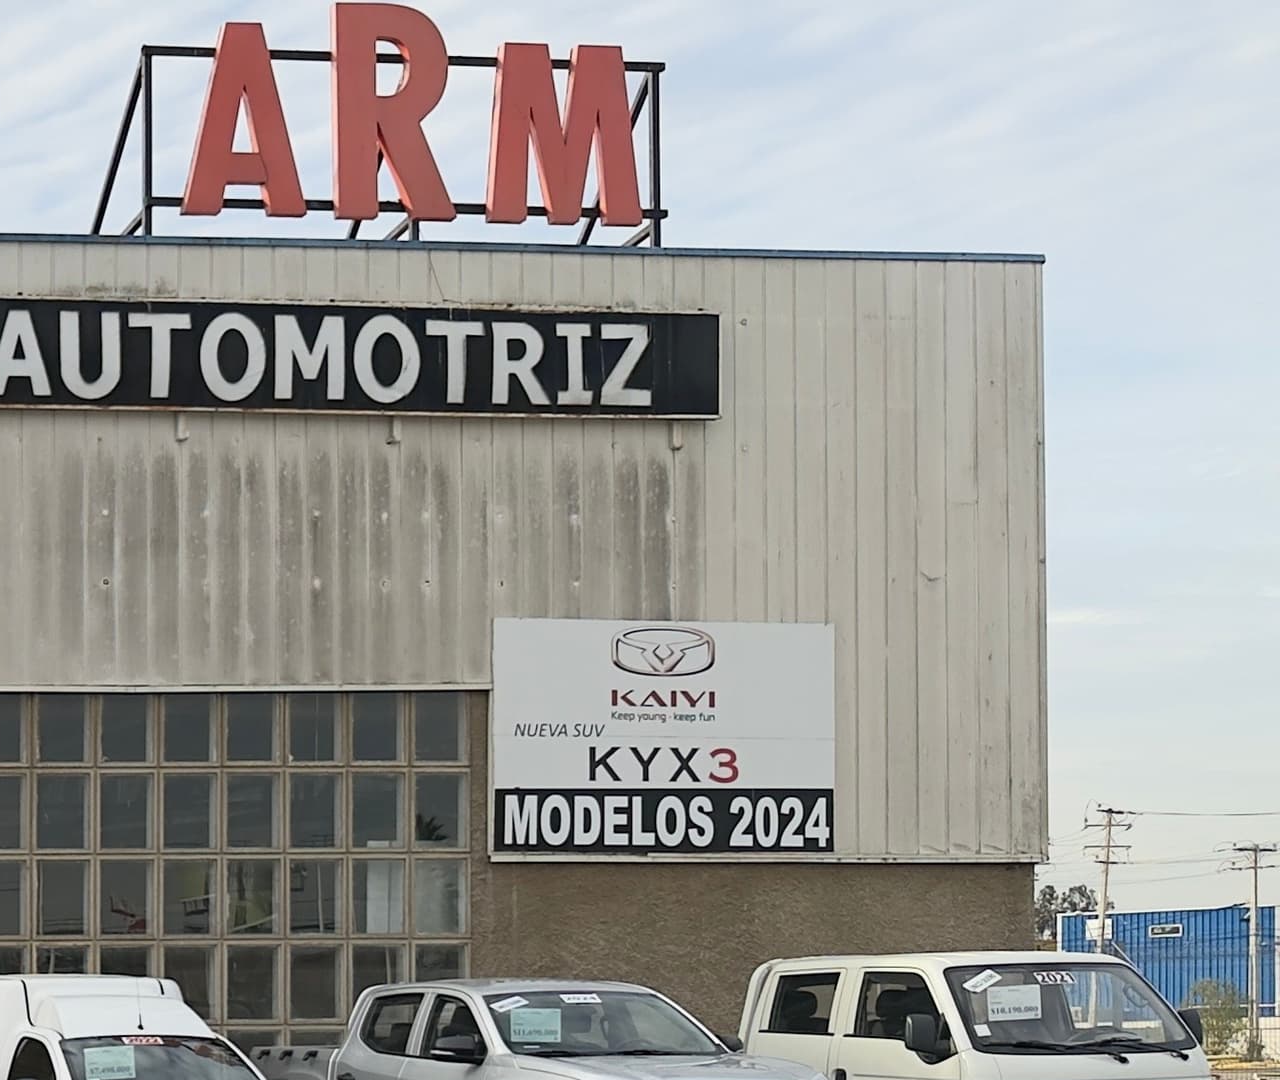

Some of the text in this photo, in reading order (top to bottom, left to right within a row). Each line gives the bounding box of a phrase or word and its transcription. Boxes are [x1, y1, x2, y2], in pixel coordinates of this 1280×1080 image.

[181, 2, 644, 227] ARM
[611, 689, 716, 708] KAIYI
[611, 711, 716, 723] Keep young keep fun
[514, 722, 606, 738] NUEVA SUV
[588, 745, 740, 784] KYX3
[503, 793, 830, 849] MODELOS 2024
[1035, 971, 1076, 984] 2021
